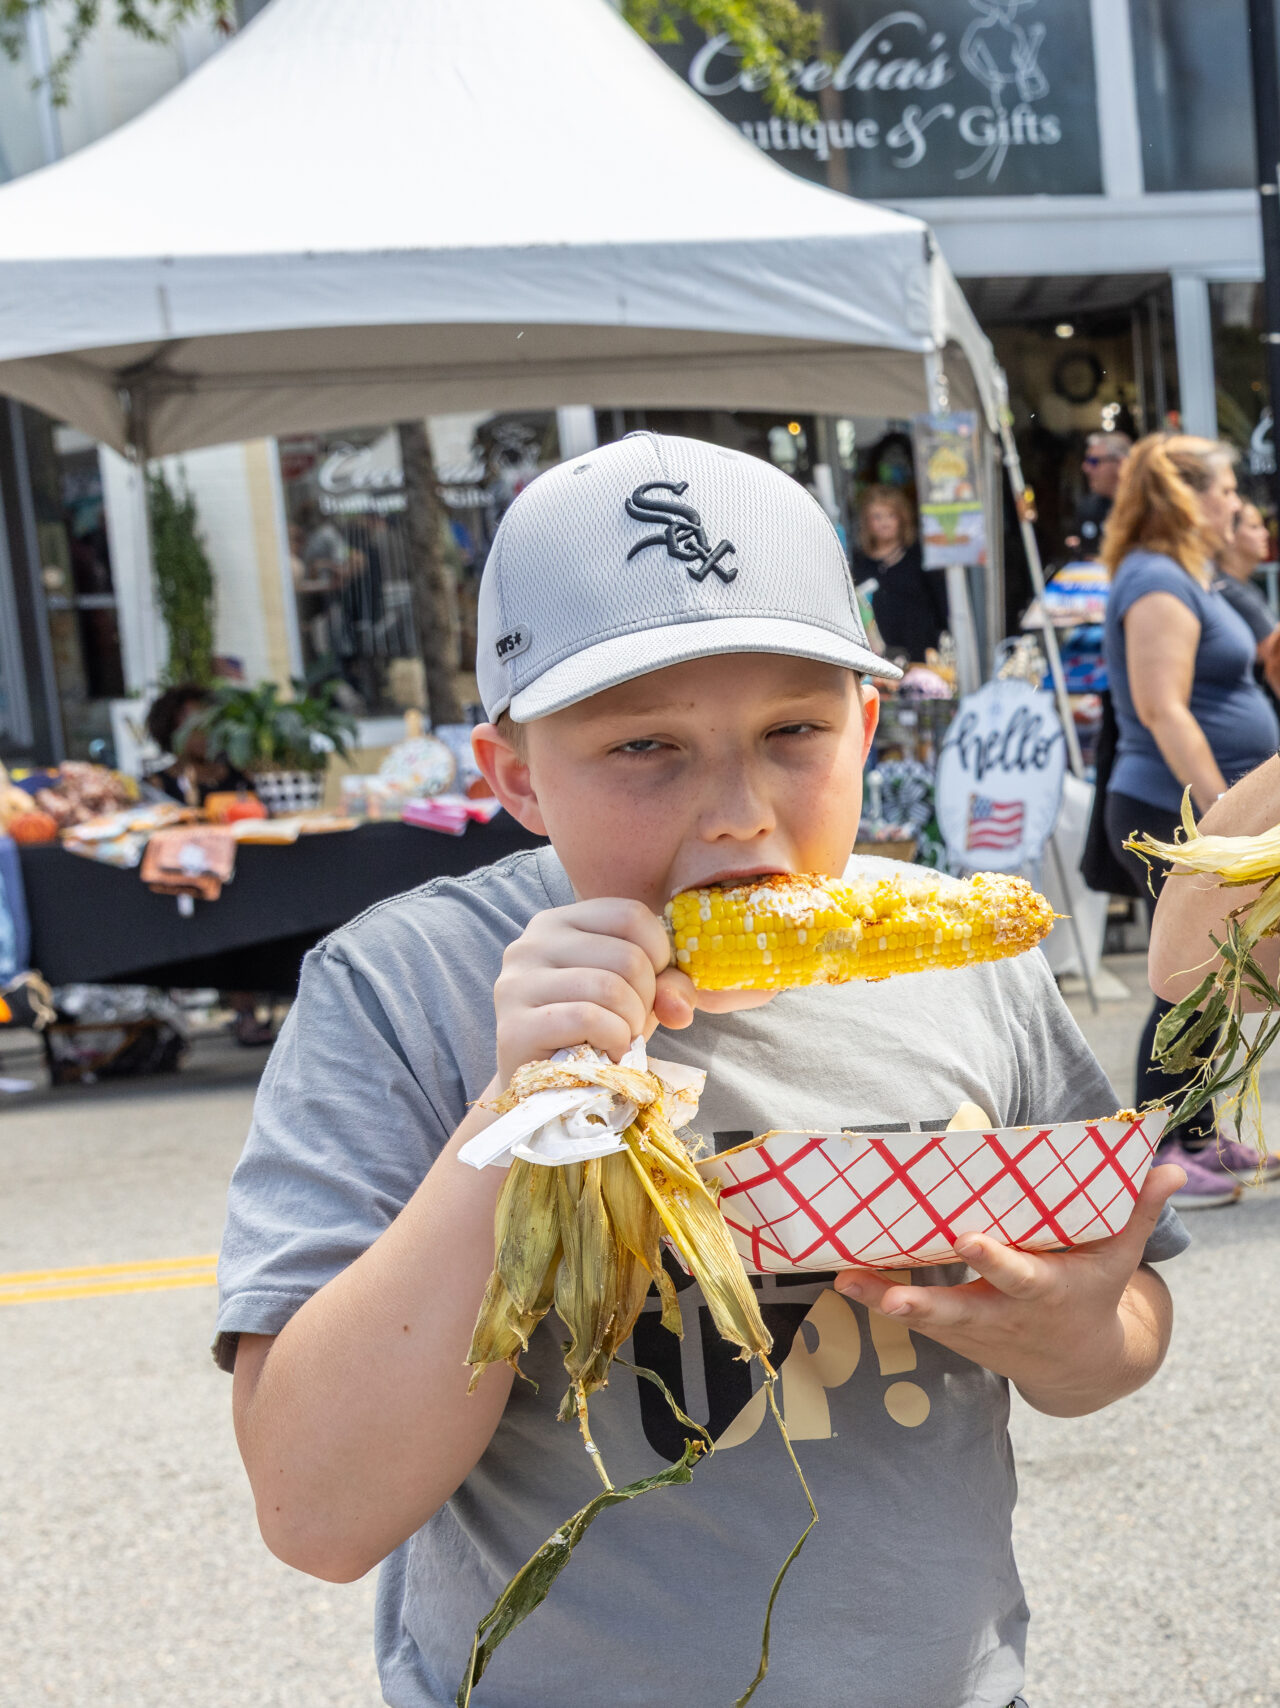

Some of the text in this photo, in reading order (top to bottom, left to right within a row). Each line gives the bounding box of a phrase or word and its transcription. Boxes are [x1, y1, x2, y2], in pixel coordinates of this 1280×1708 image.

[735, 102, 1062, 169] utique & Gifts
[625, 481, 739, 584] Sox
[943, 705, 1064, 782] hello
